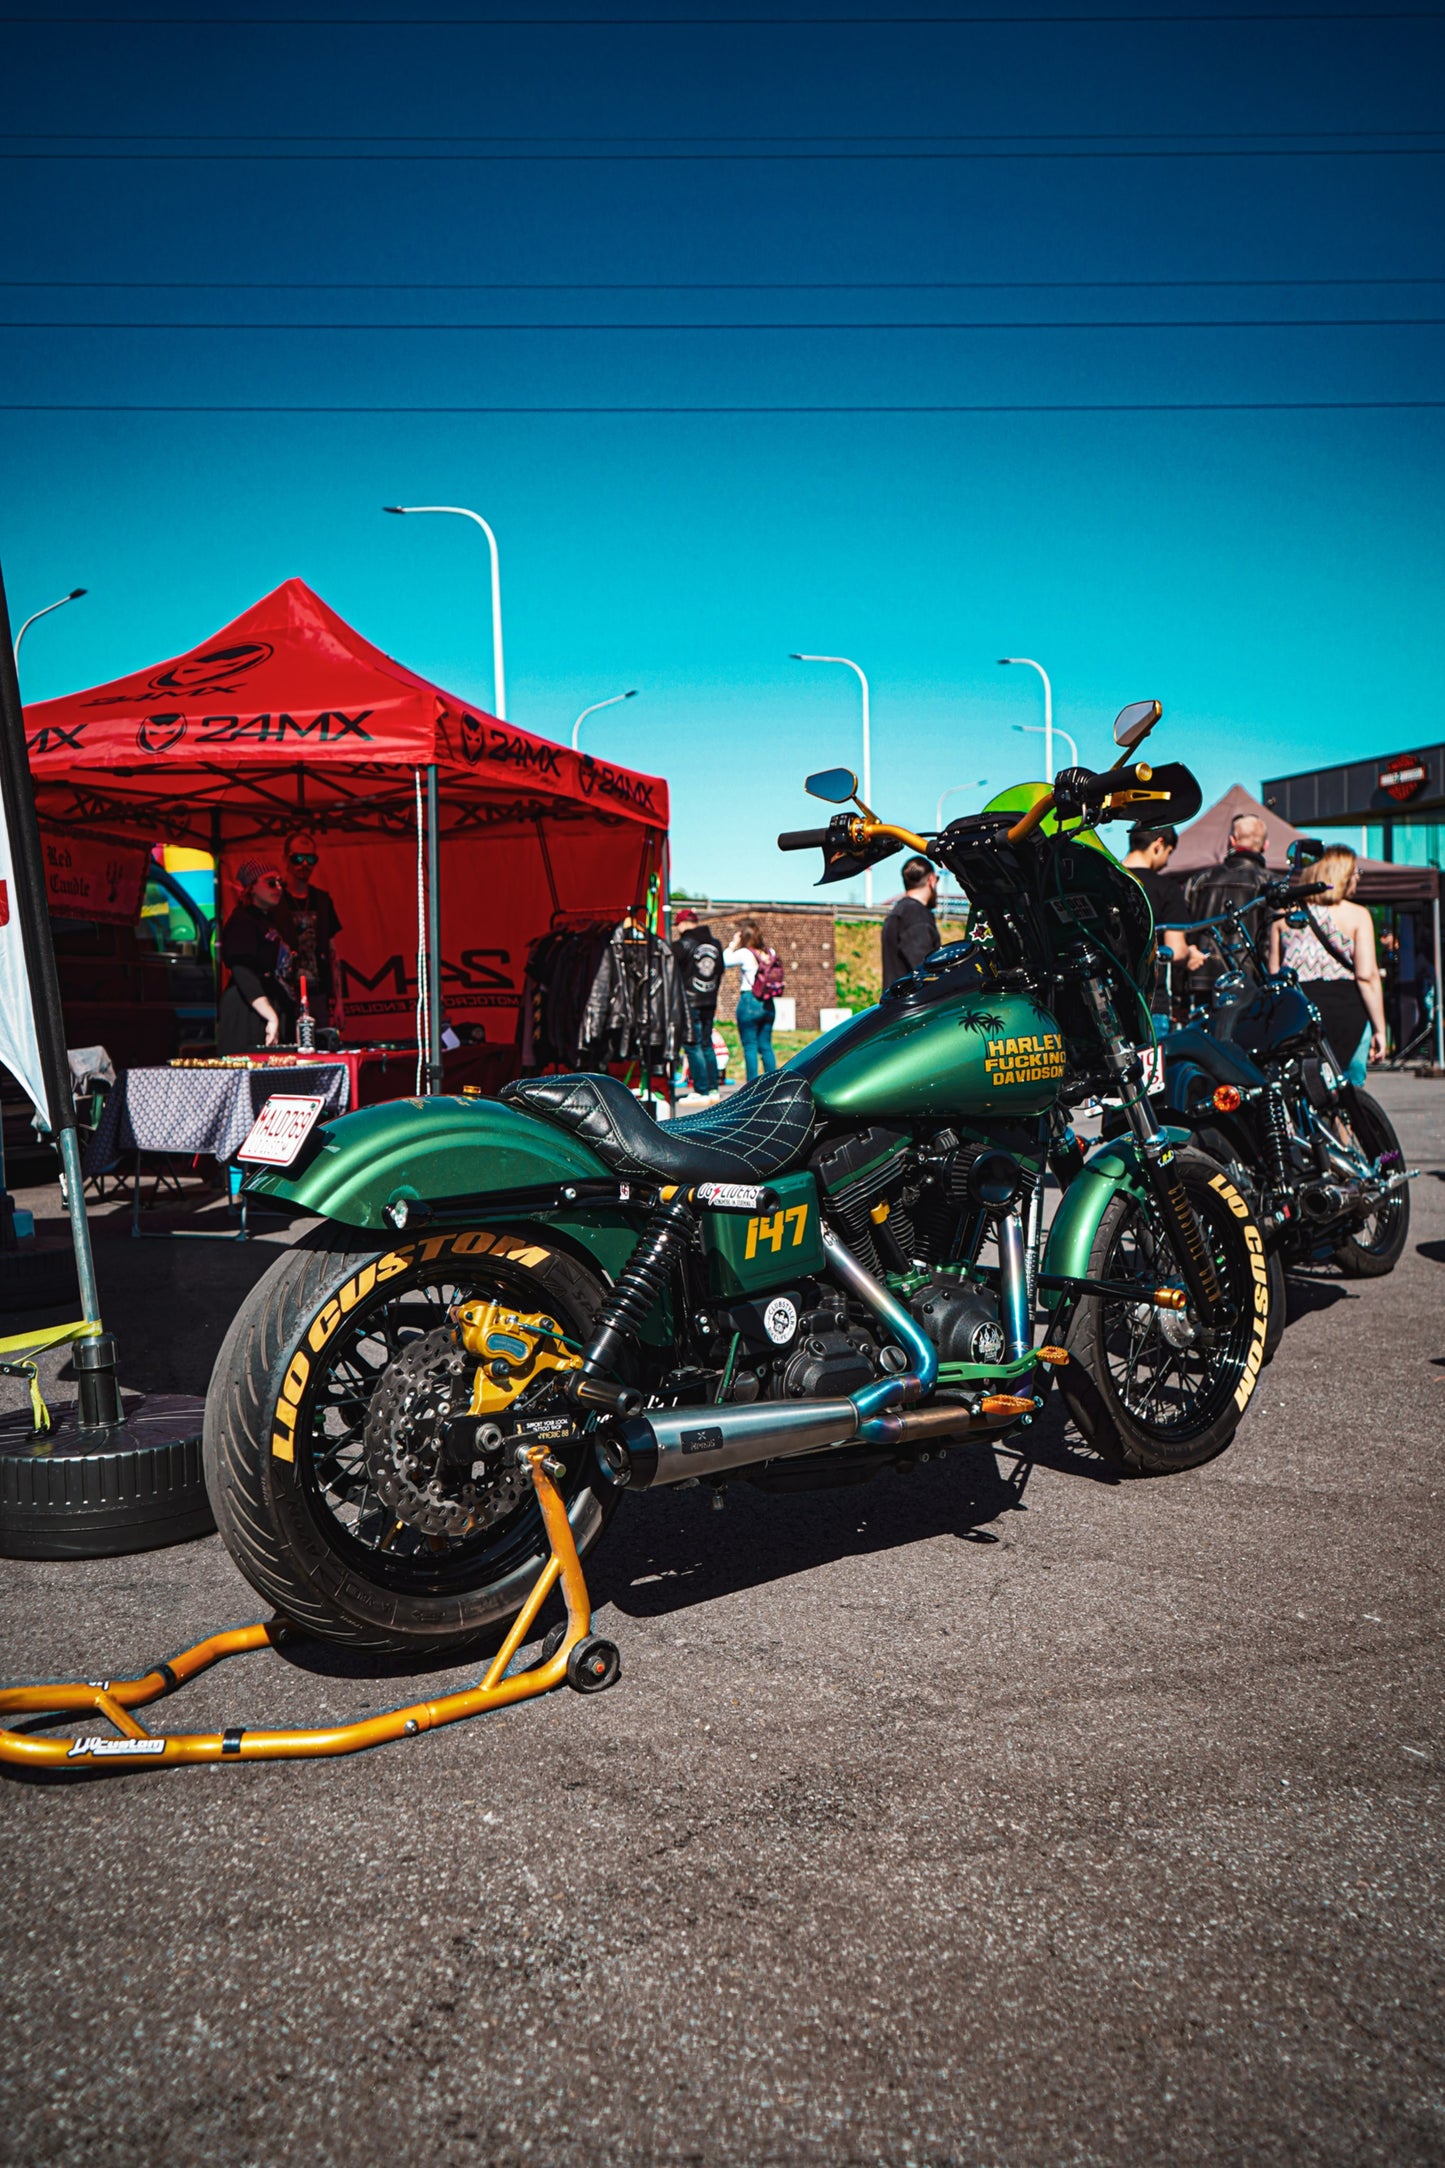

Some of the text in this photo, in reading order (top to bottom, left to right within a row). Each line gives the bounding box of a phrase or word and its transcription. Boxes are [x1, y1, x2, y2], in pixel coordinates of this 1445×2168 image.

[194, 710, 375, 743] 24MX
[489, 730, 562, 777] 24MX
[599, 767, 656, 810] 24MX
[988, 1034, 1062, 1057] HARLEY
[745, 1204, 808, 1260] 147
[1207, 1173, 1249, 1219] LIO
[1233, 1225, 1269, 1412] CUSTOM
[272, 1231, 551, 1463] LIO CUSTOM
